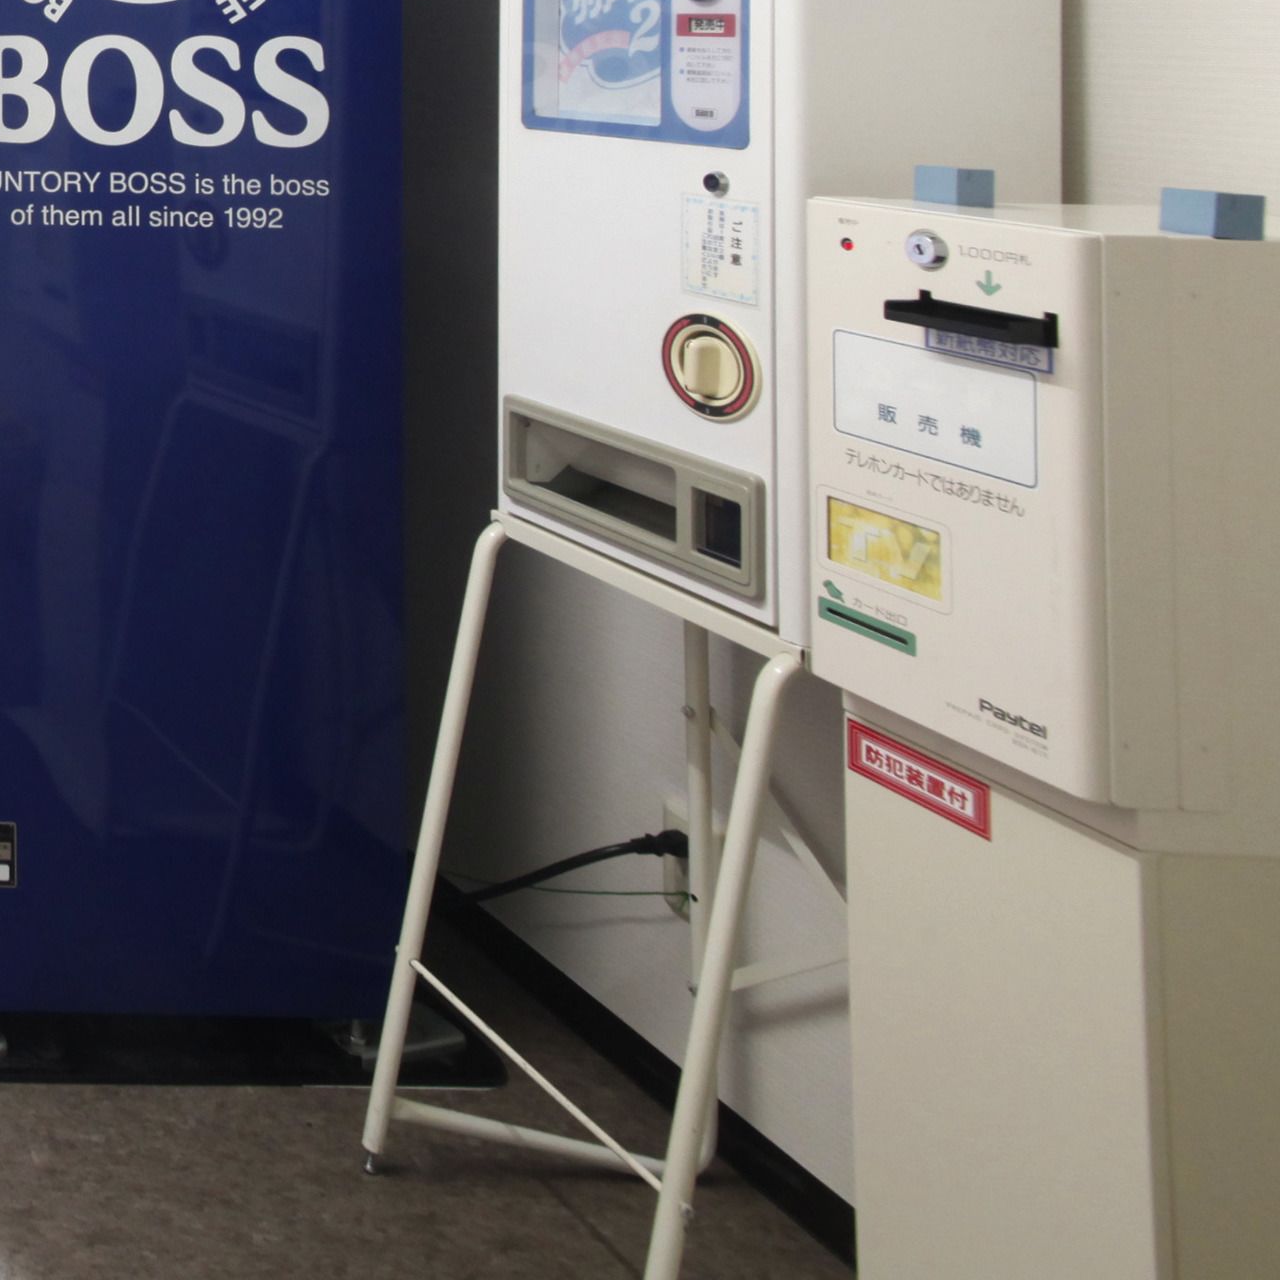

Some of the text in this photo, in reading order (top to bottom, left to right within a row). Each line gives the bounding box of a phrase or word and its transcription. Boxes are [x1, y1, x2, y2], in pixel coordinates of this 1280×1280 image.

[108, 171, 186, 195] BOSS
[194, 173, 215, 195] is
[222, 173, 262, 196] the
[270, 173, 330, 197] boss
[10, 203, 284, 229] of them all since 1992
[978, 697, 1048, 740] Paytel
[864, 742, 969, 811] 防犯装置付
